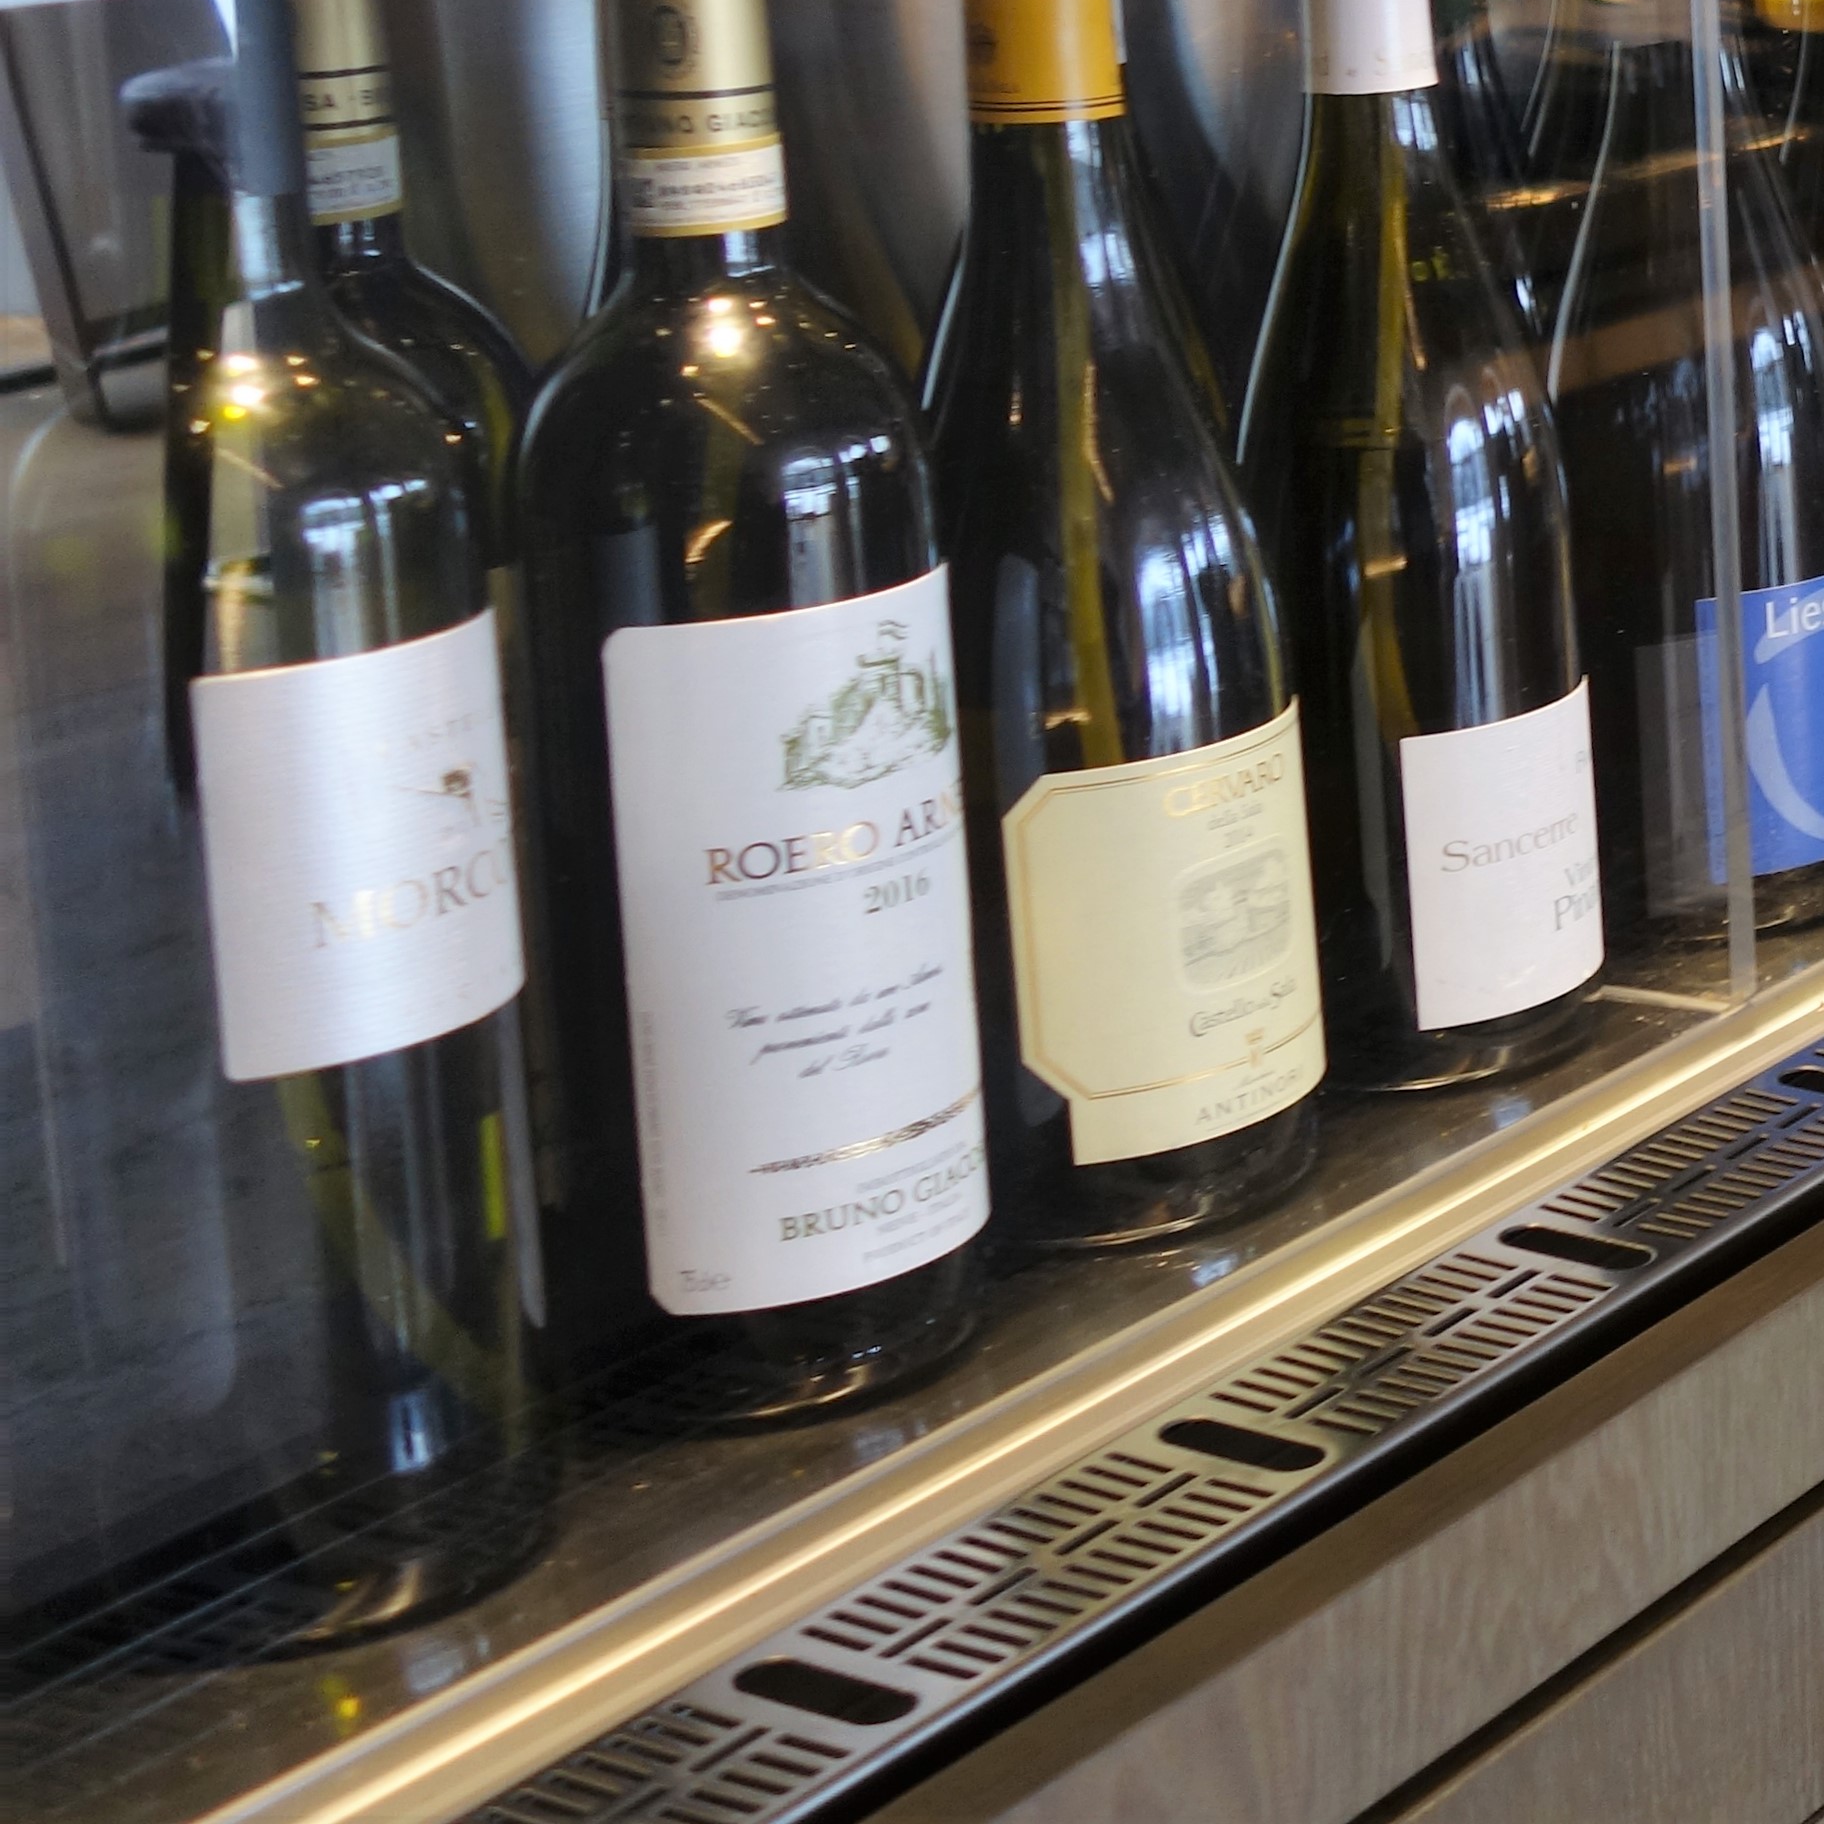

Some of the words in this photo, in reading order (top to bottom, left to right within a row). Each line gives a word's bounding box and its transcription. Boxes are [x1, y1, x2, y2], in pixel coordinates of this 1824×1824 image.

[1163, 752, 1285, 819] CERVARO
[703, 820, 881, 885] ROERO
[1440, 812, 1579, 873] Sancerre
[863, 868, 931, 914] 2016
[780, 1189, 904, 1242] BRUNO
